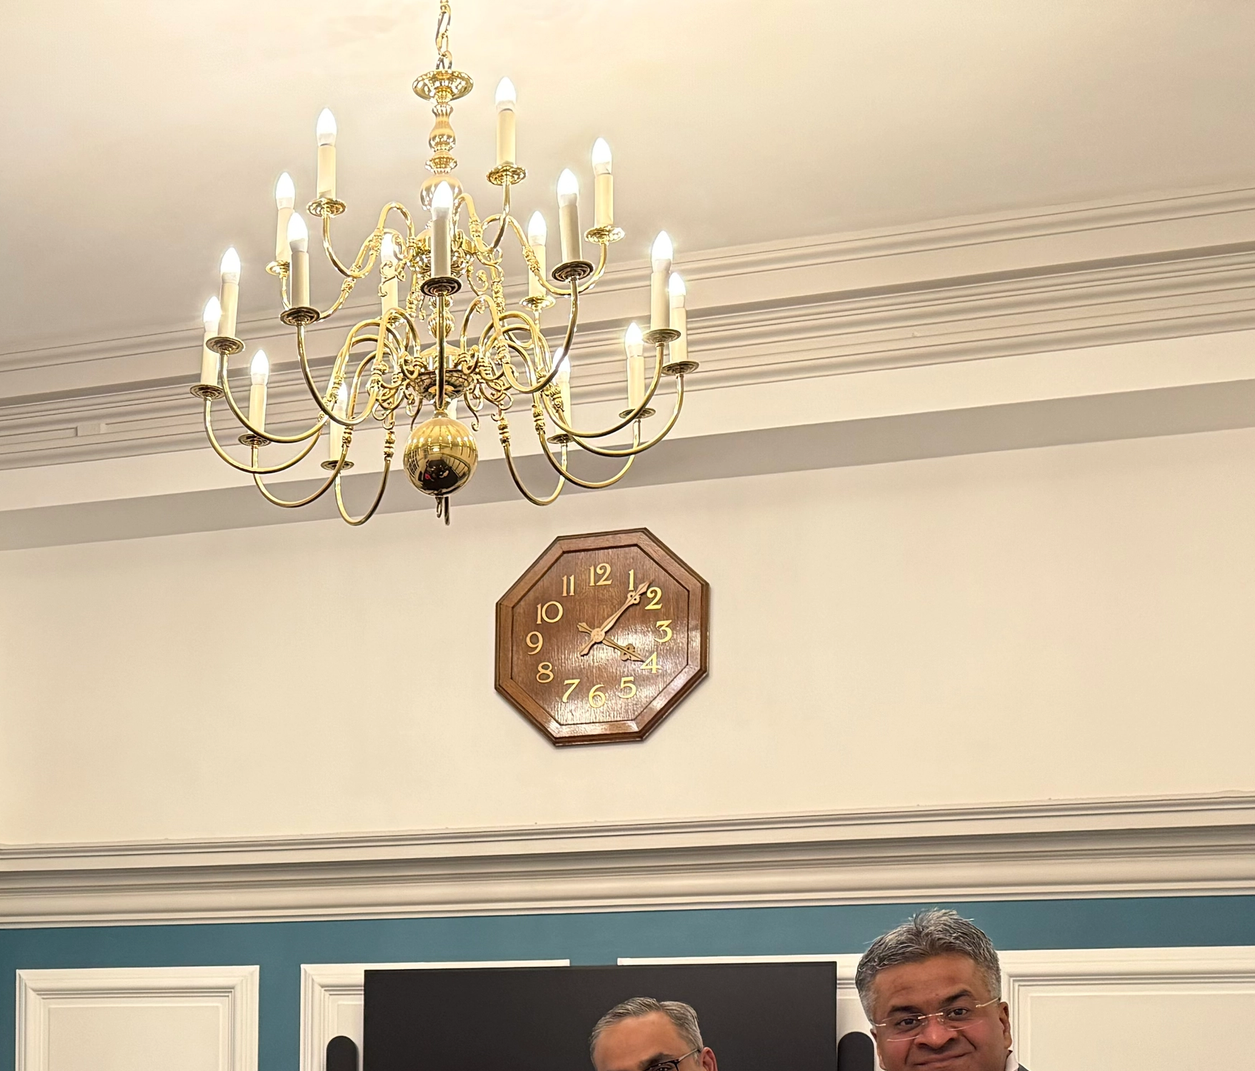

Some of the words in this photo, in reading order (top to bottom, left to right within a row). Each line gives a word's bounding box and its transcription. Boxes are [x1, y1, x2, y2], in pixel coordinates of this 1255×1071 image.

[562, 575, 575, 596] 11
[589, 563, 612, 586] 12
[628, 569, 635, 591] 1
[645, 587, 663, 610] 2
[536, 601, 564, 624] 10
[526, 631, 543, 655] 9
[654, 620, 673, 643] 3
[536, 662, 554, 683] 8
[640, 652, 662, 674] 4
[562, 679, 581, 703] 7
[589, 684, 606, 708] 6
[619, 676, 637, 699] 5
